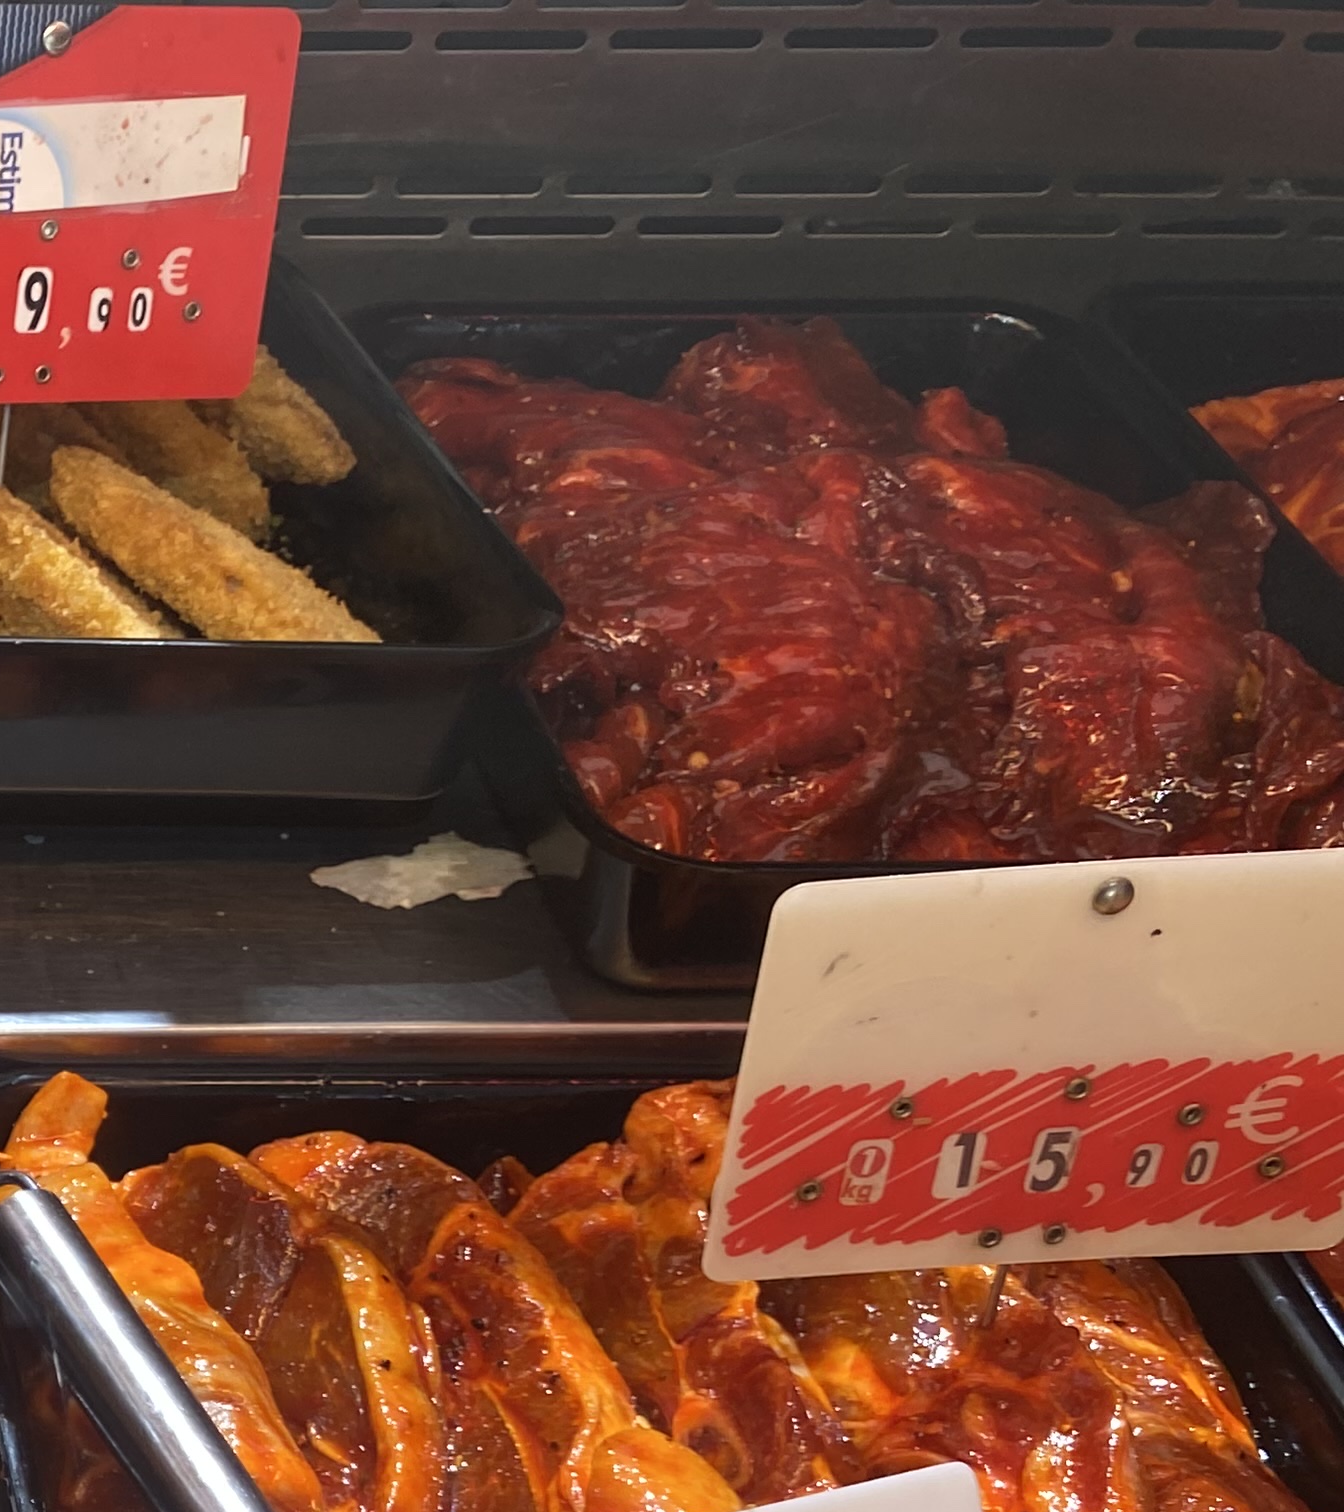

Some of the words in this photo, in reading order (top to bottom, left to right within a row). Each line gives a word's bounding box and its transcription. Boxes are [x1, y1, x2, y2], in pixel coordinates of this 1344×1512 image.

[158, 247, 193, 296] €
[1224, 1076, 1303, 1145] €
[841, 1181, 871, 1204] kg
